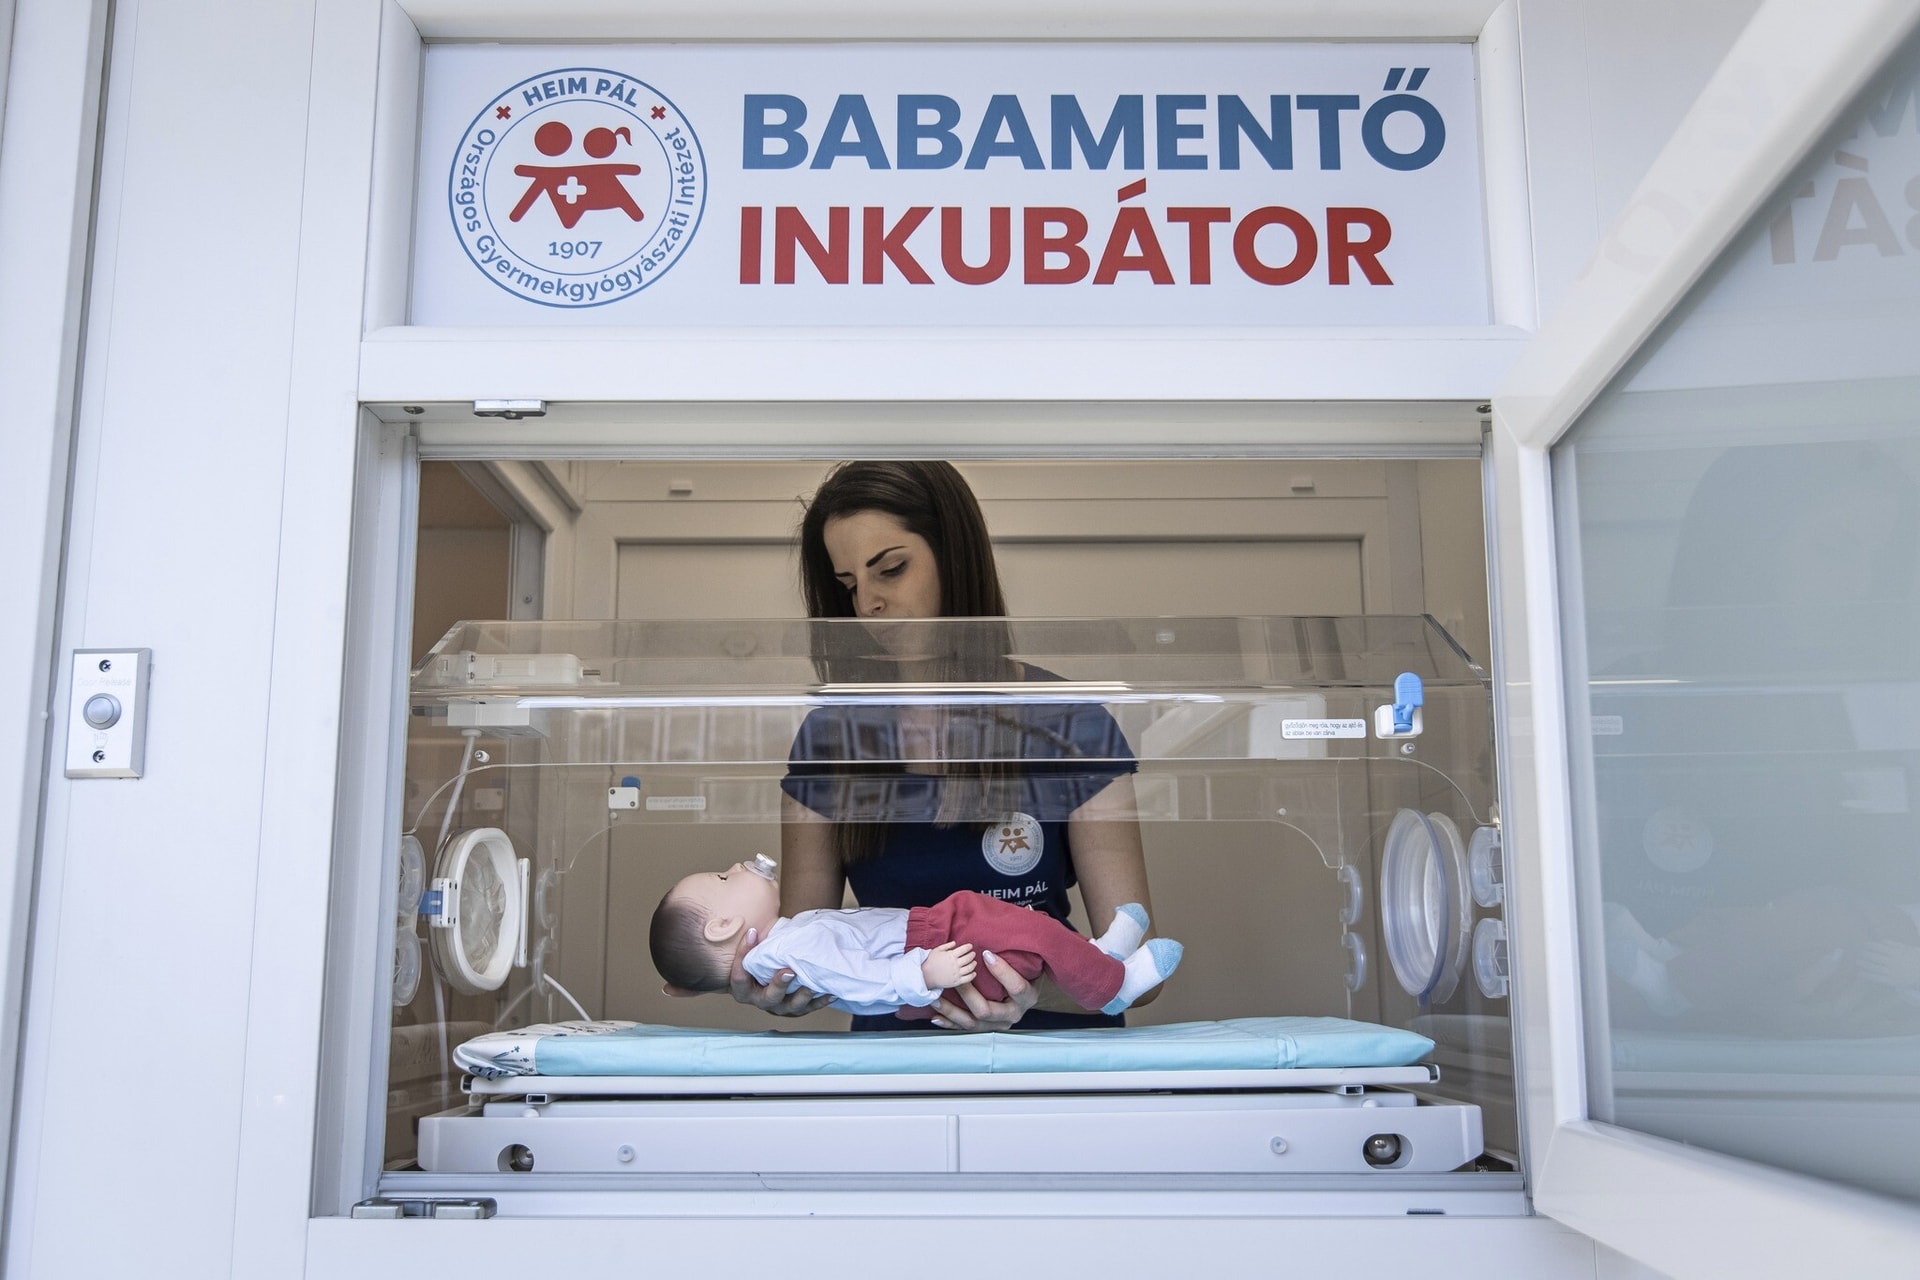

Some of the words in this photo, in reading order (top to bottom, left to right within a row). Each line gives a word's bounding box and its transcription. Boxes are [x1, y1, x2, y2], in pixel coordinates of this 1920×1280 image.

[522, 77, 588, 106] HEIM
[595, 78, 637, 107] PÁL
[742, 67, 1446, 171] BABAMENTŐ
[456, 129, 495, 232] Országos
[476, 211, 690, 301] Gyermekgyógyászati
[665, 127, 695, 205] Intézet
[739, 177, 1394, 285] INKUBÁTOR
[548, 241, 602, 259] 1907
[1025, 881, 1048, 896] PÁL
